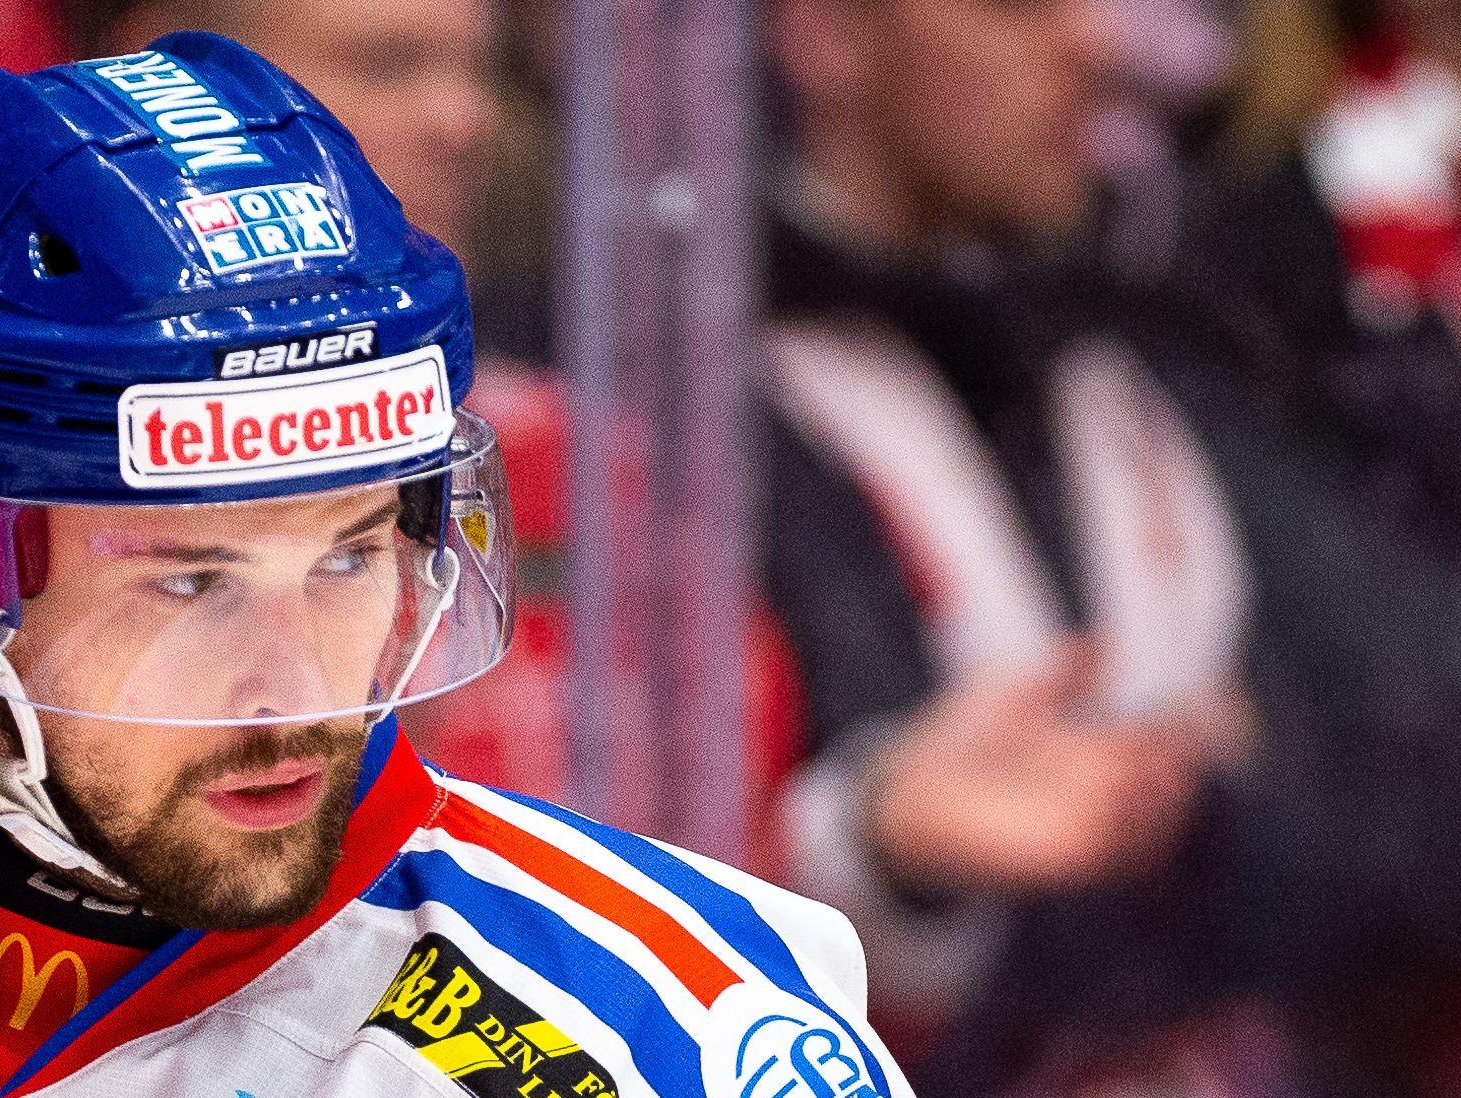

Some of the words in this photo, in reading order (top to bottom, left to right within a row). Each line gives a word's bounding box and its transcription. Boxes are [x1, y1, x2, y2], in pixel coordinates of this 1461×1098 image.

[220, 328, 375, 379] BAUER
[144, 384, 435, 467] telecenter
[368, 947, 482, 1039] &B
[474, 1014, 544, 1074] DIN
